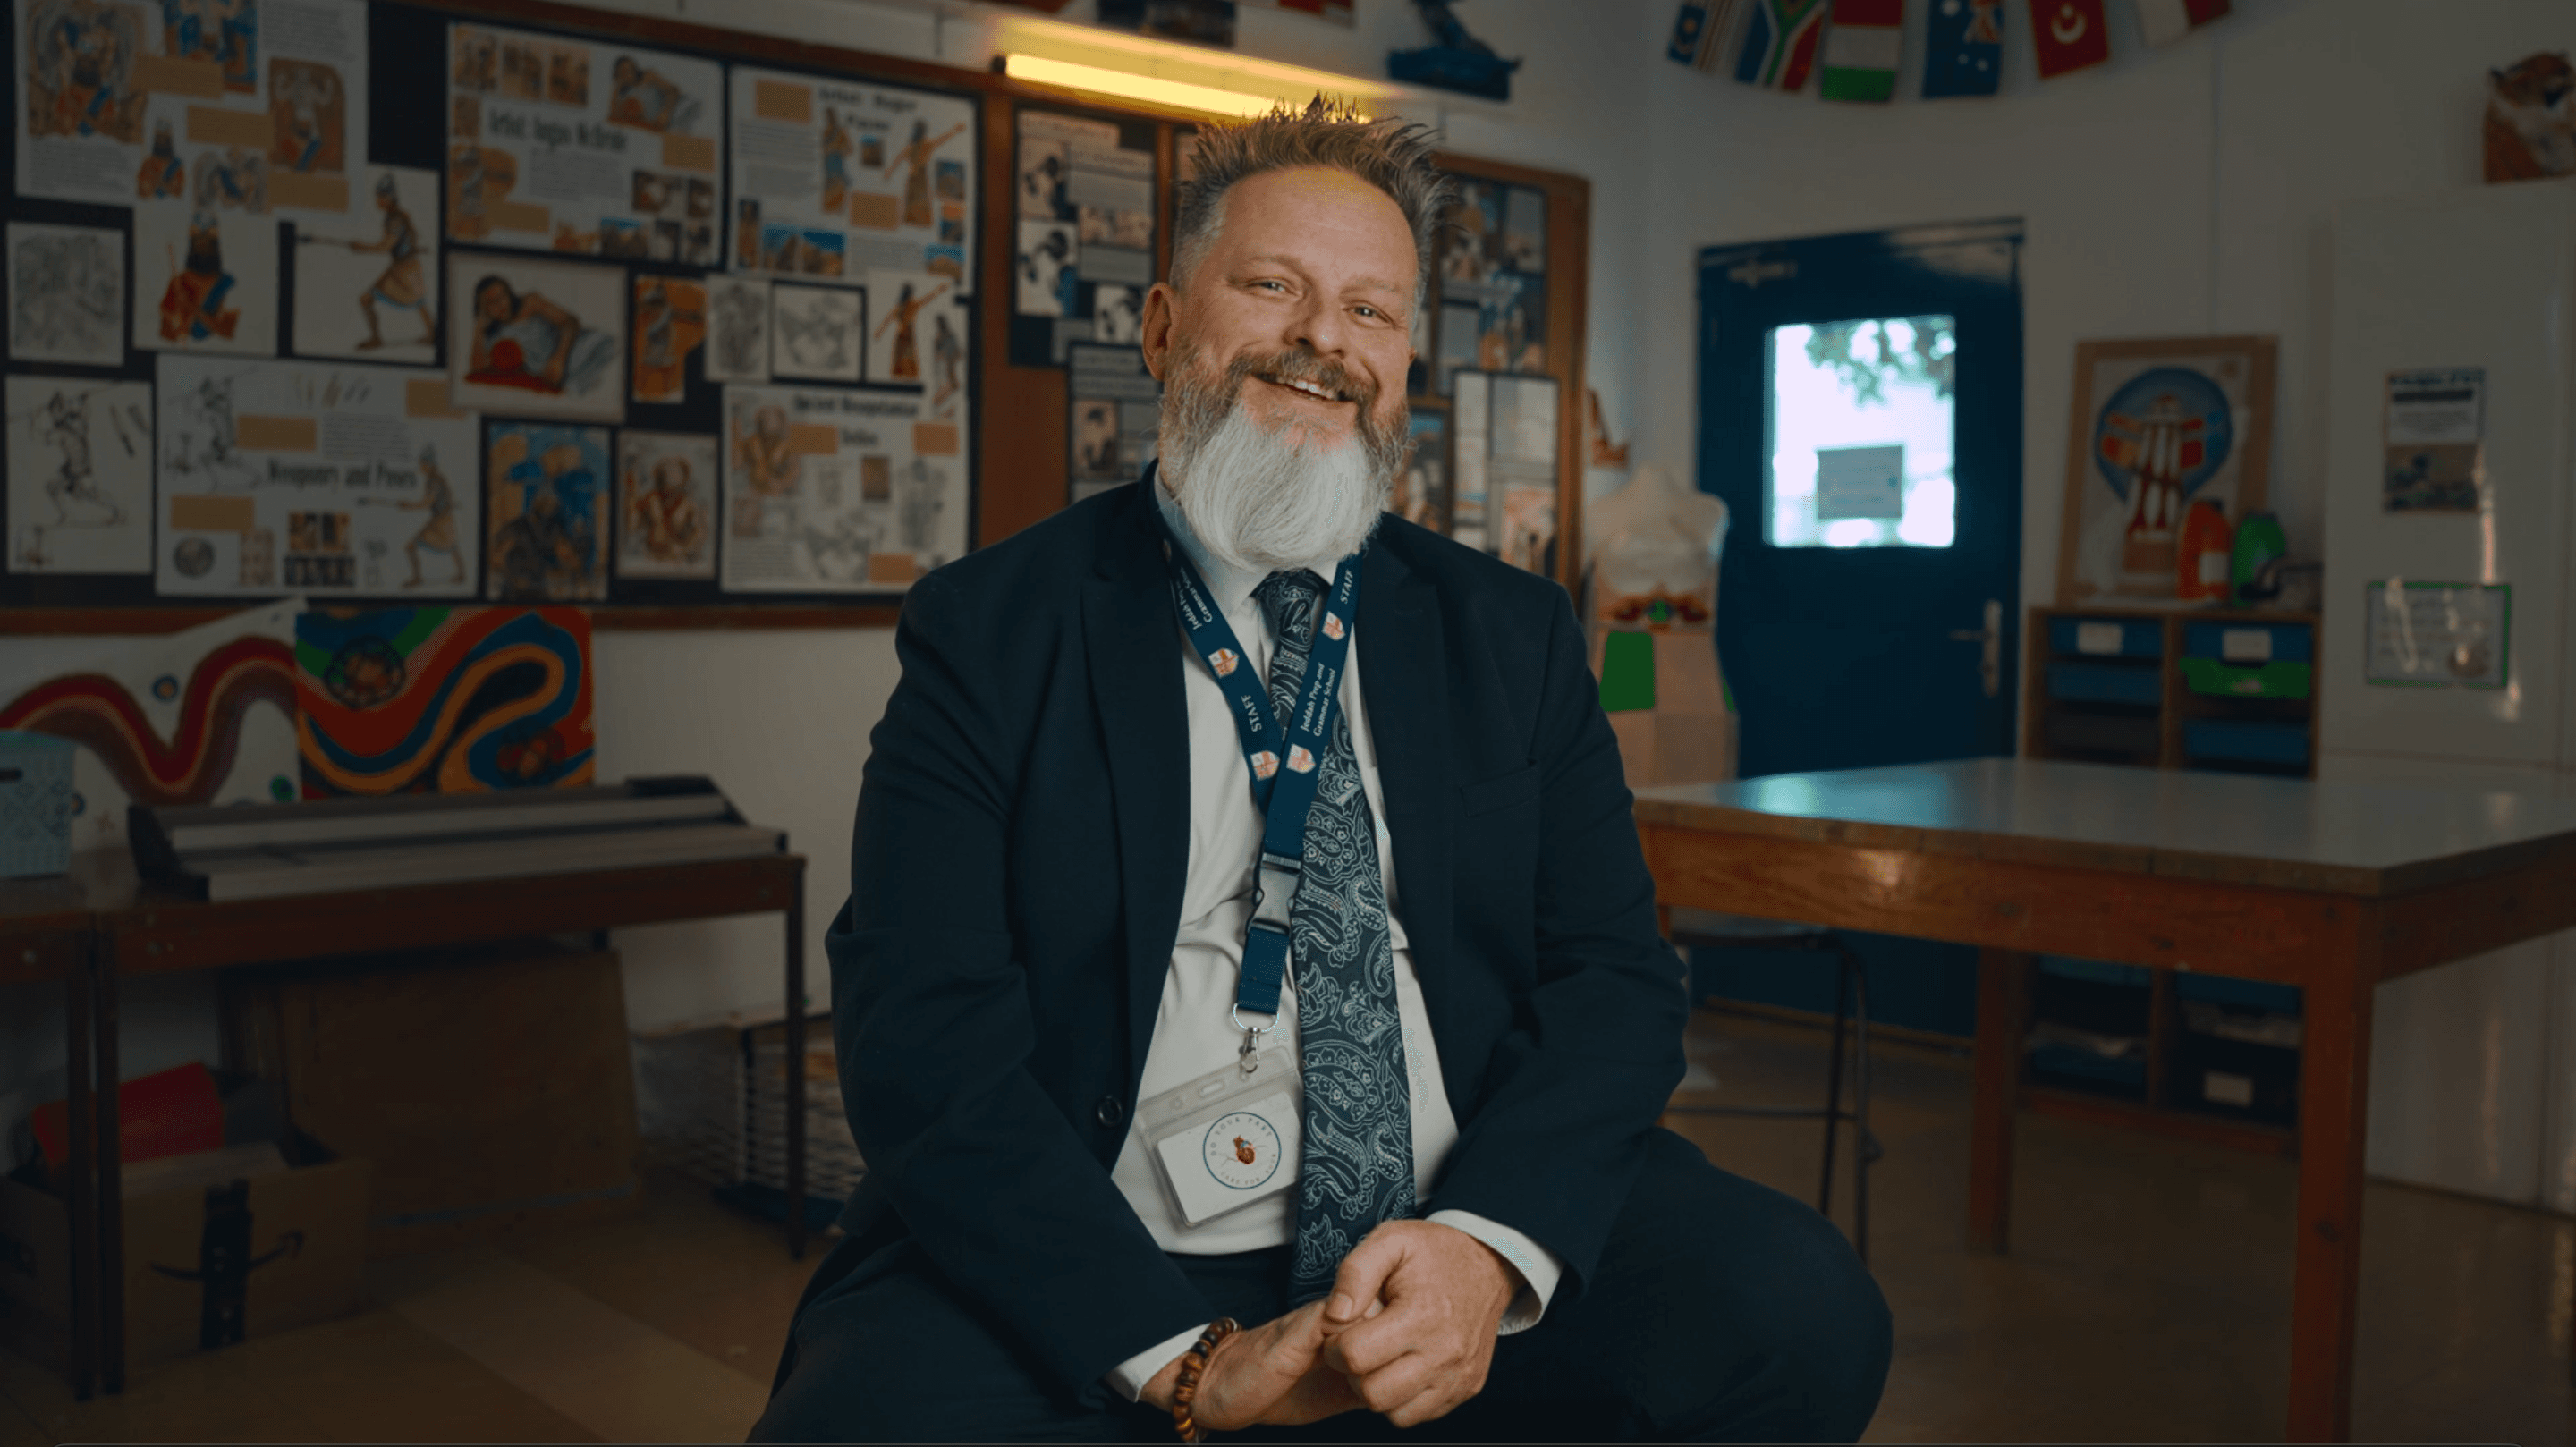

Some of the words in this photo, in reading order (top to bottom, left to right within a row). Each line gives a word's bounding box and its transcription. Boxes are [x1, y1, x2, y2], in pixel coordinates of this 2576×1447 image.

[1190, 586, 1213, 623] Grammar
[1340, 569, 1354, 605] STAFF
[1241, 695, 1263, 732] STAFF
[1300, 700, 1316, 732] Jeddah
[1309, 680, 1323, 700] Prep
[1317, 662, 1326, 681] and
[1313, 697, 1330, 737] Grammar
[1324, 668, 1336, 698] School
[1215, 1117, 1240, 1135] YOUR
[1249, 1117, 1271, 1136] PART
